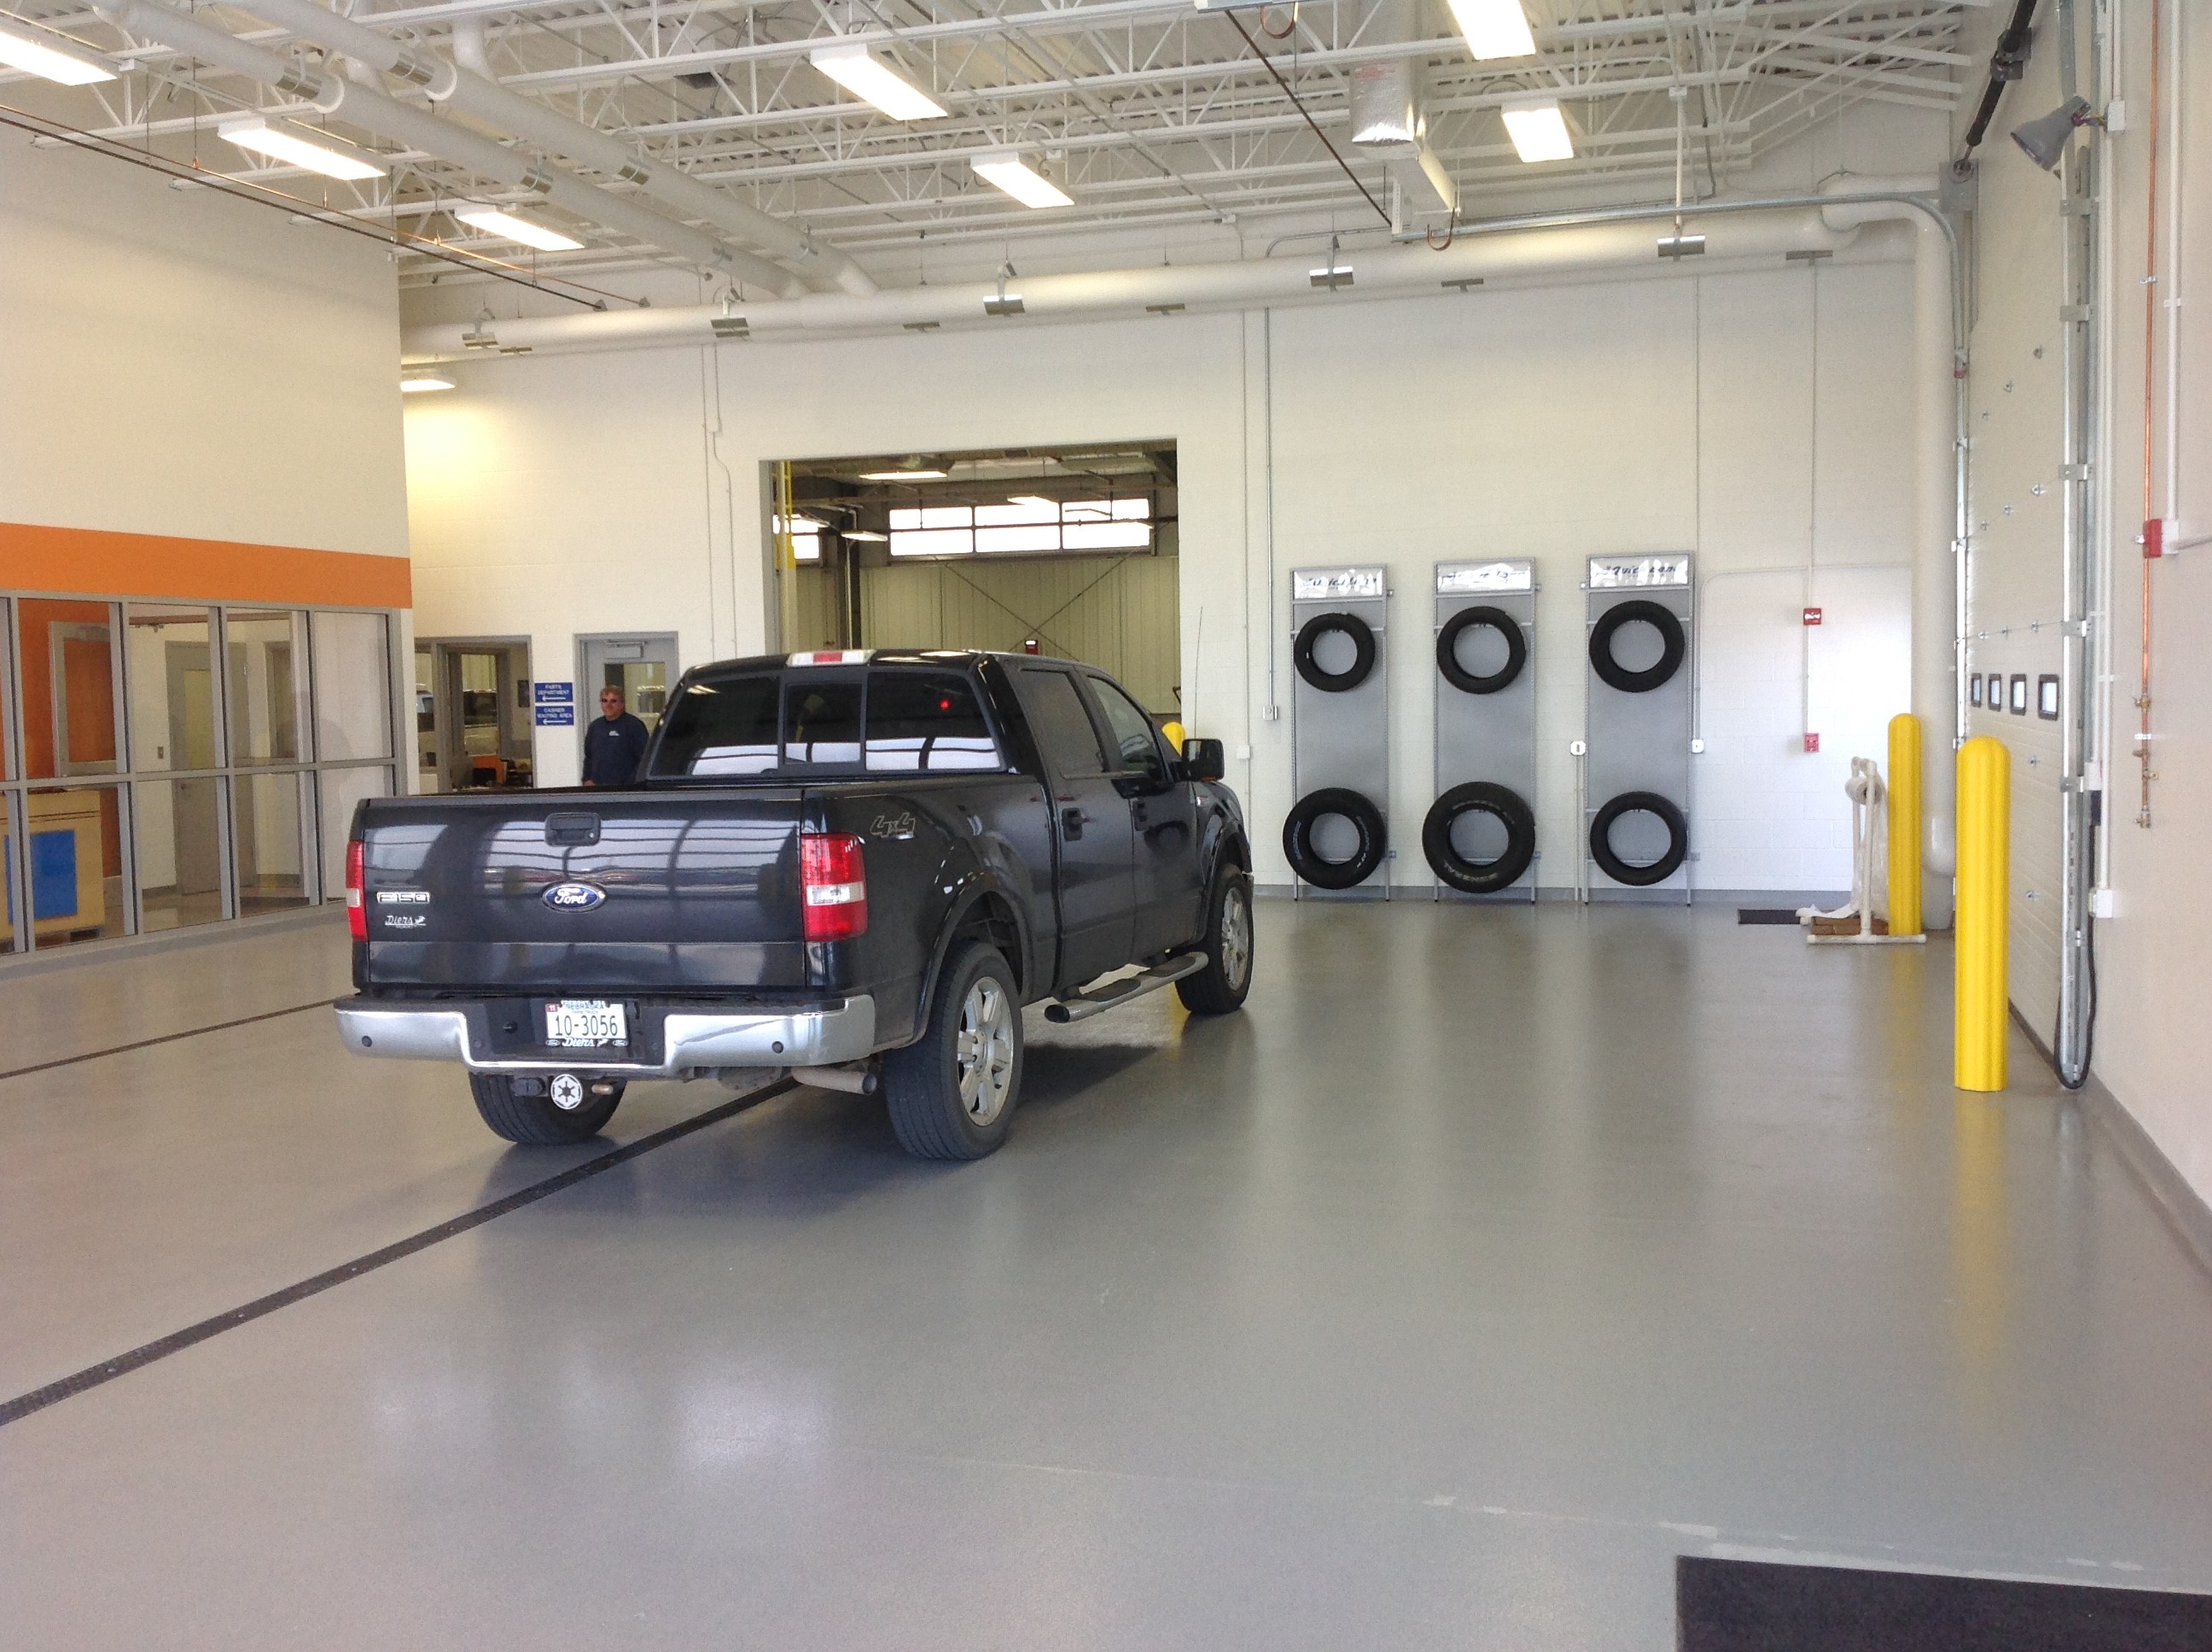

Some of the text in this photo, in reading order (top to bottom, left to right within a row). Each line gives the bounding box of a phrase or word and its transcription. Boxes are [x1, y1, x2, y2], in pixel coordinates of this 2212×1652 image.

[1612, 566, 1644, 575] Quic
[554, 887, 589, 905] Ford
[556, 1015, 618, 1037] 10-3056
